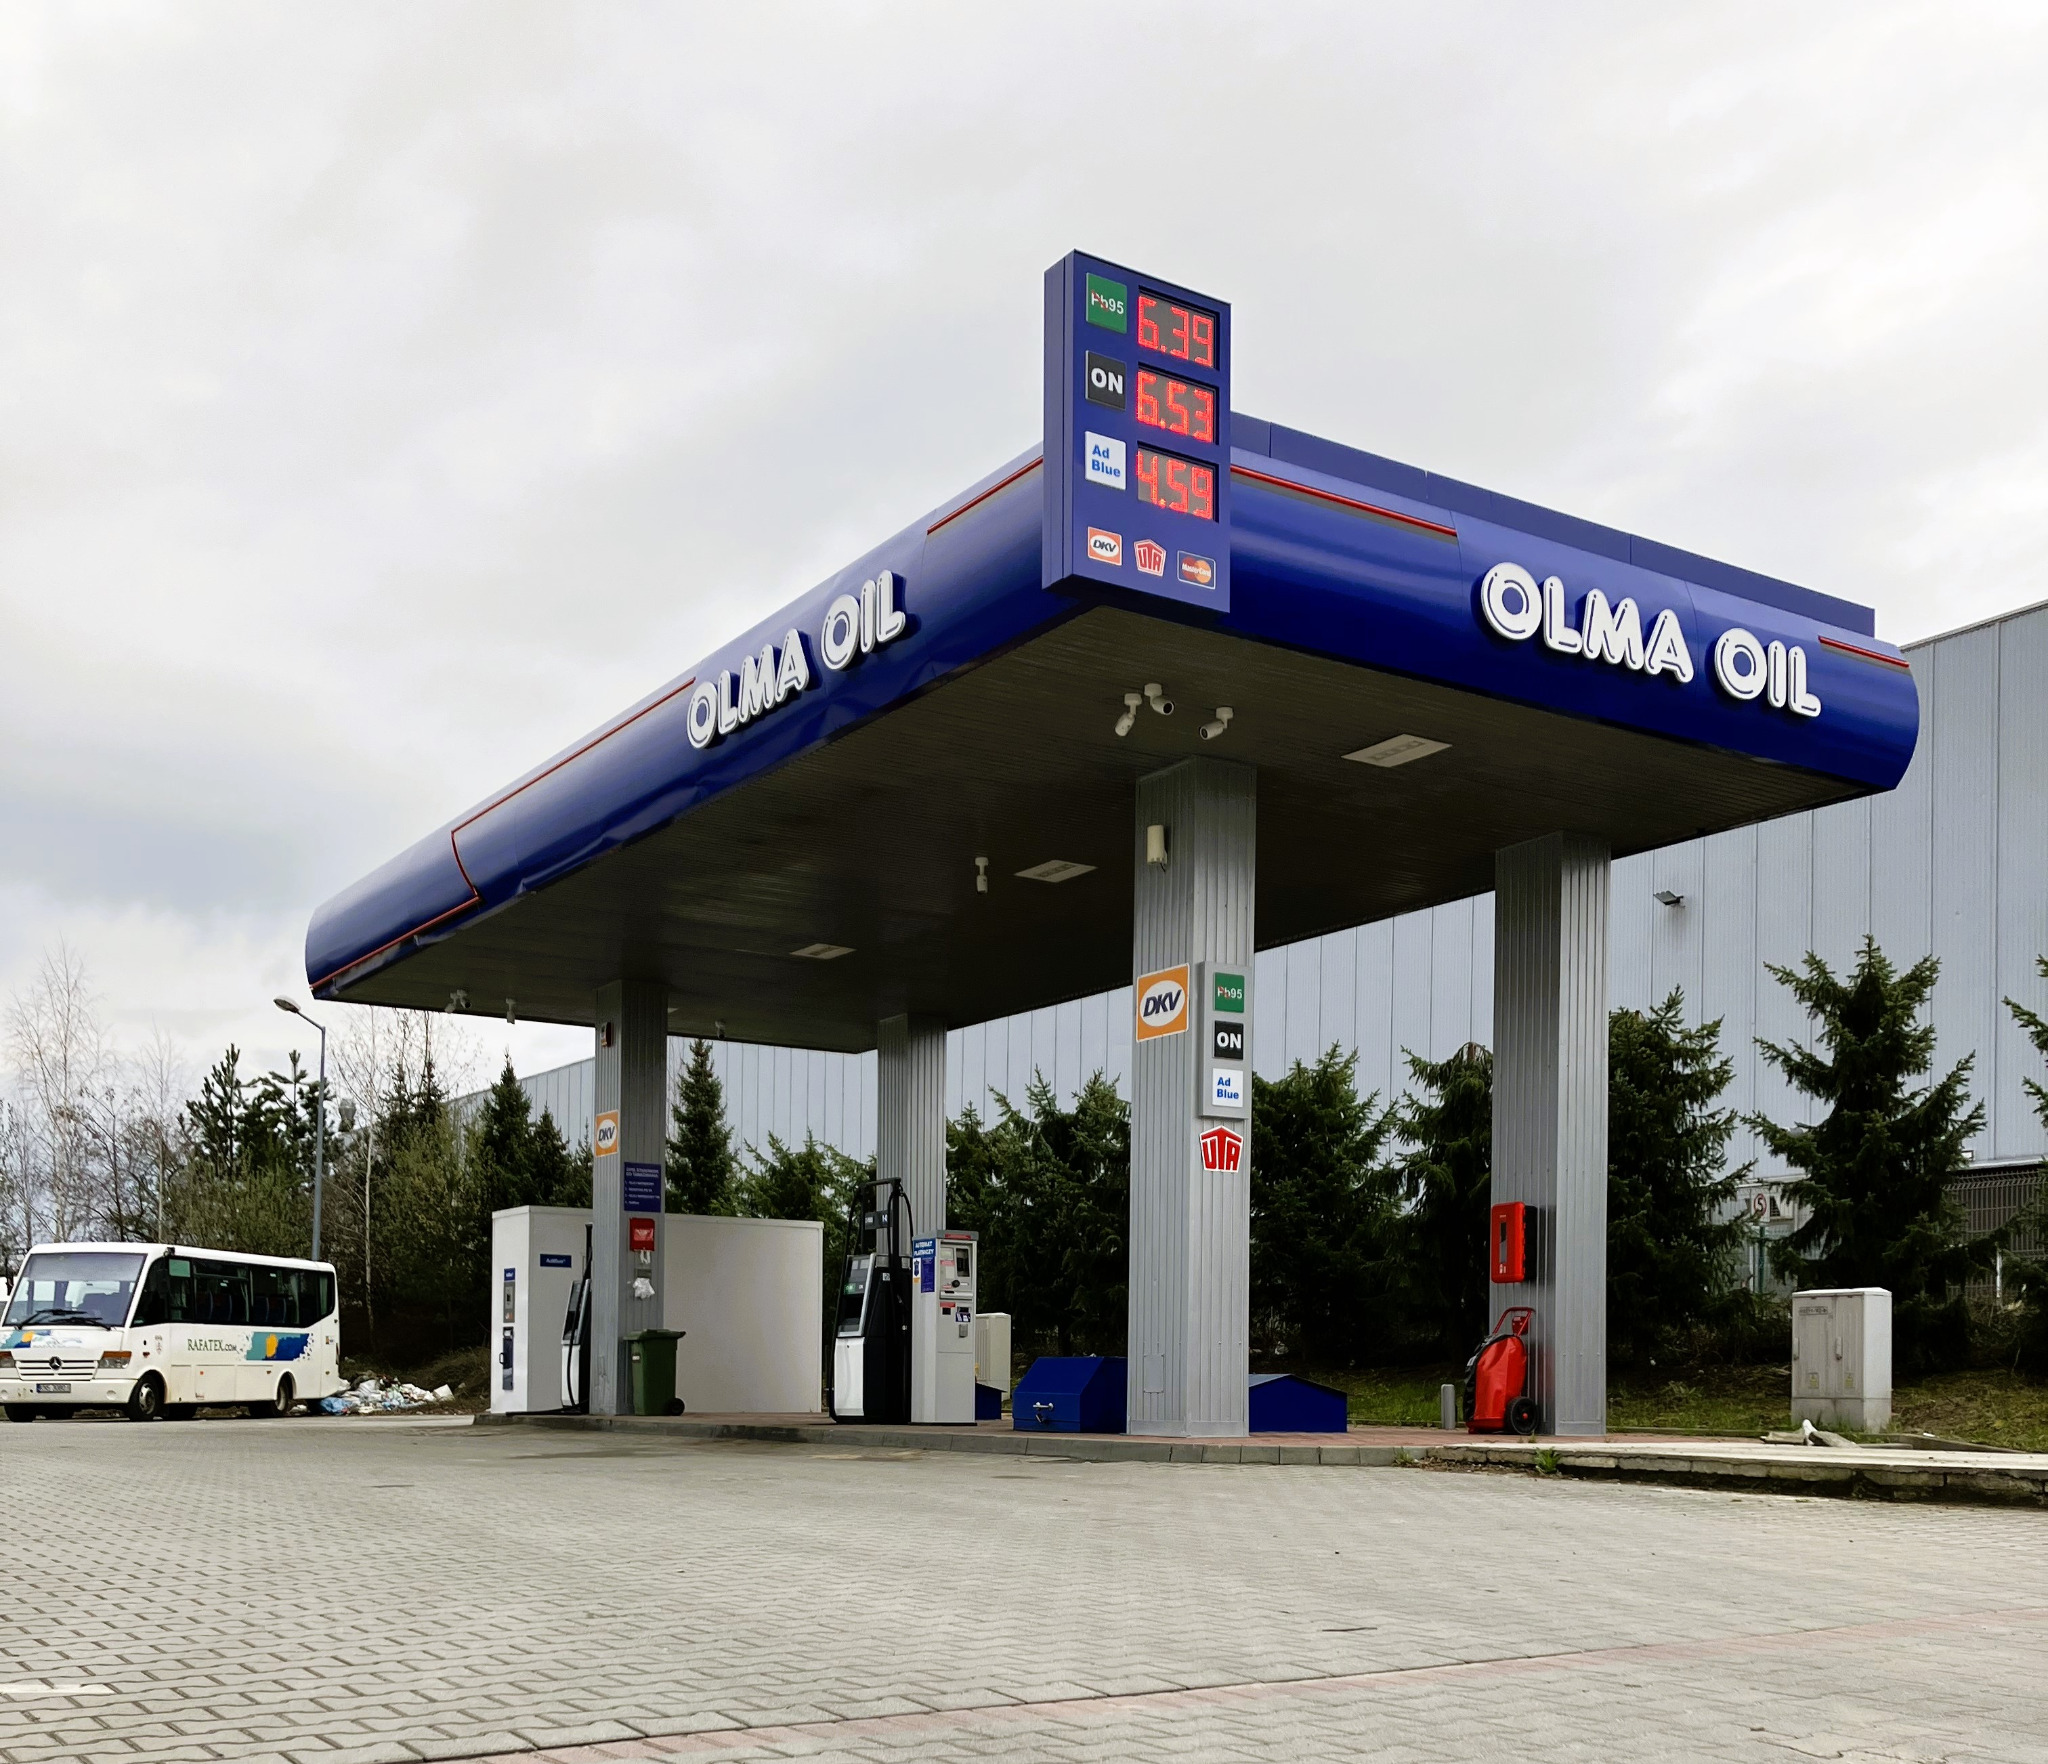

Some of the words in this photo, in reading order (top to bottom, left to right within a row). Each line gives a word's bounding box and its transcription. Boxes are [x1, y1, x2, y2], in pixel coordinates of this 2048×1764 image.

[1091, 291, 1124, 315] Pb95
[1138, 295, 1213, 367] 6.39
[1091, 367, 1123, 394] ON
[1136, 370, 1213, 443] 6.53
[1092, 444, 1109, 459] Ad
[1091, 458, 1121, 478] Blue
[1136, 450, 1213, 520] 4.59
[1093, 539, 1117, 553] DKV
[1137, 541, 1163, 573] UTA
[1481, 562, 1695, 684] OLMA
[1714, 627, 1822, 718] OIL
[687, 628, 810, 749] OLMA
[820, 569, 906, 670] OIL
[1143, 989, 1182, 1018] DKV
[1217, 986, 1243, 1000] Pb95
[1216, 1031, 1242, 1049] ON
[1216, 1089, 1239, 1099] Blue
[1217, 1077, 1231, 1087] Ad
[598, 1125, 616, 1142] DKV
[1201, 1126, 1242, 1172] UTA
